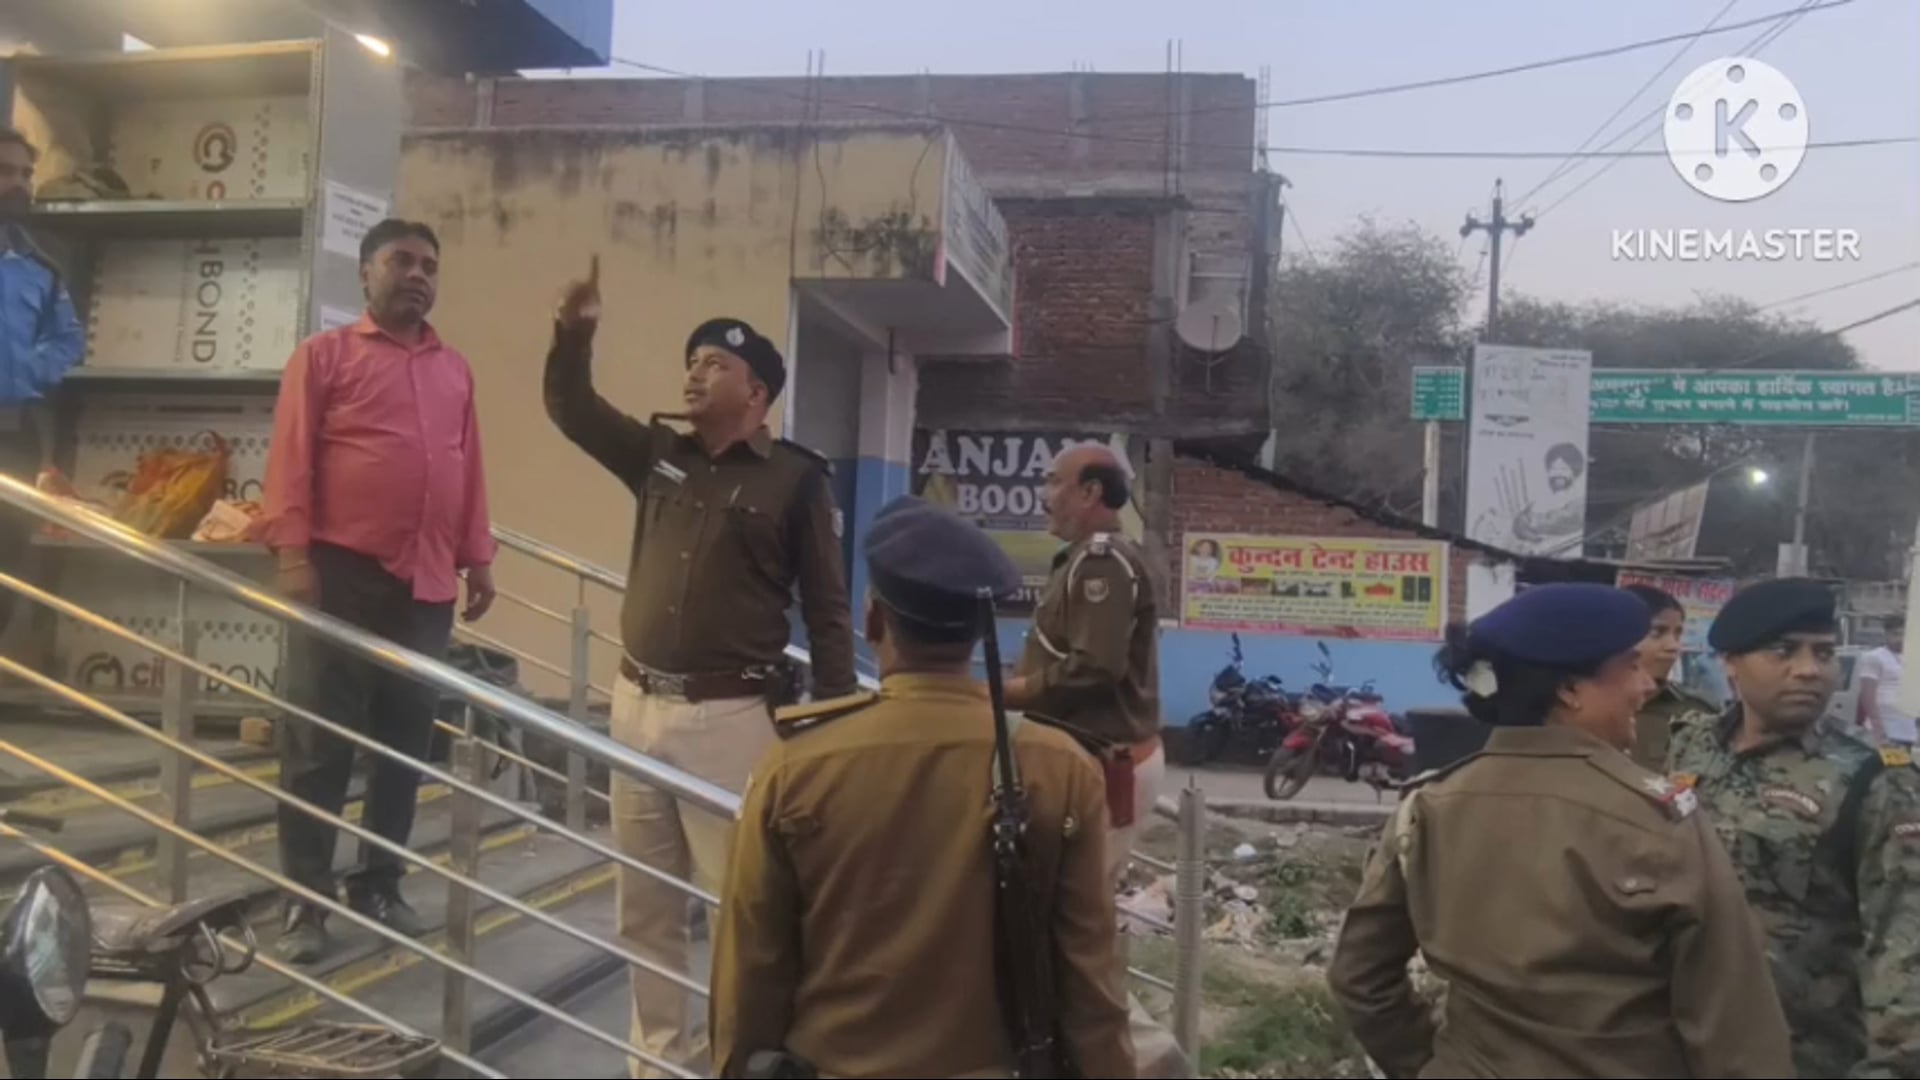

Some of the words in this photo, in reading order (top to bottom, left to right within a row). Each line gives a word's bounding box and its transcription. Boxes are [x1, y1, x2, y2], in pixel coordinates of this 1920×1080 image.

[1693, 378, 1751, 395] आपका
[1227, 545, 1303, 573] कुन्दन
[1361, 550, 1431, 574] हाउस
